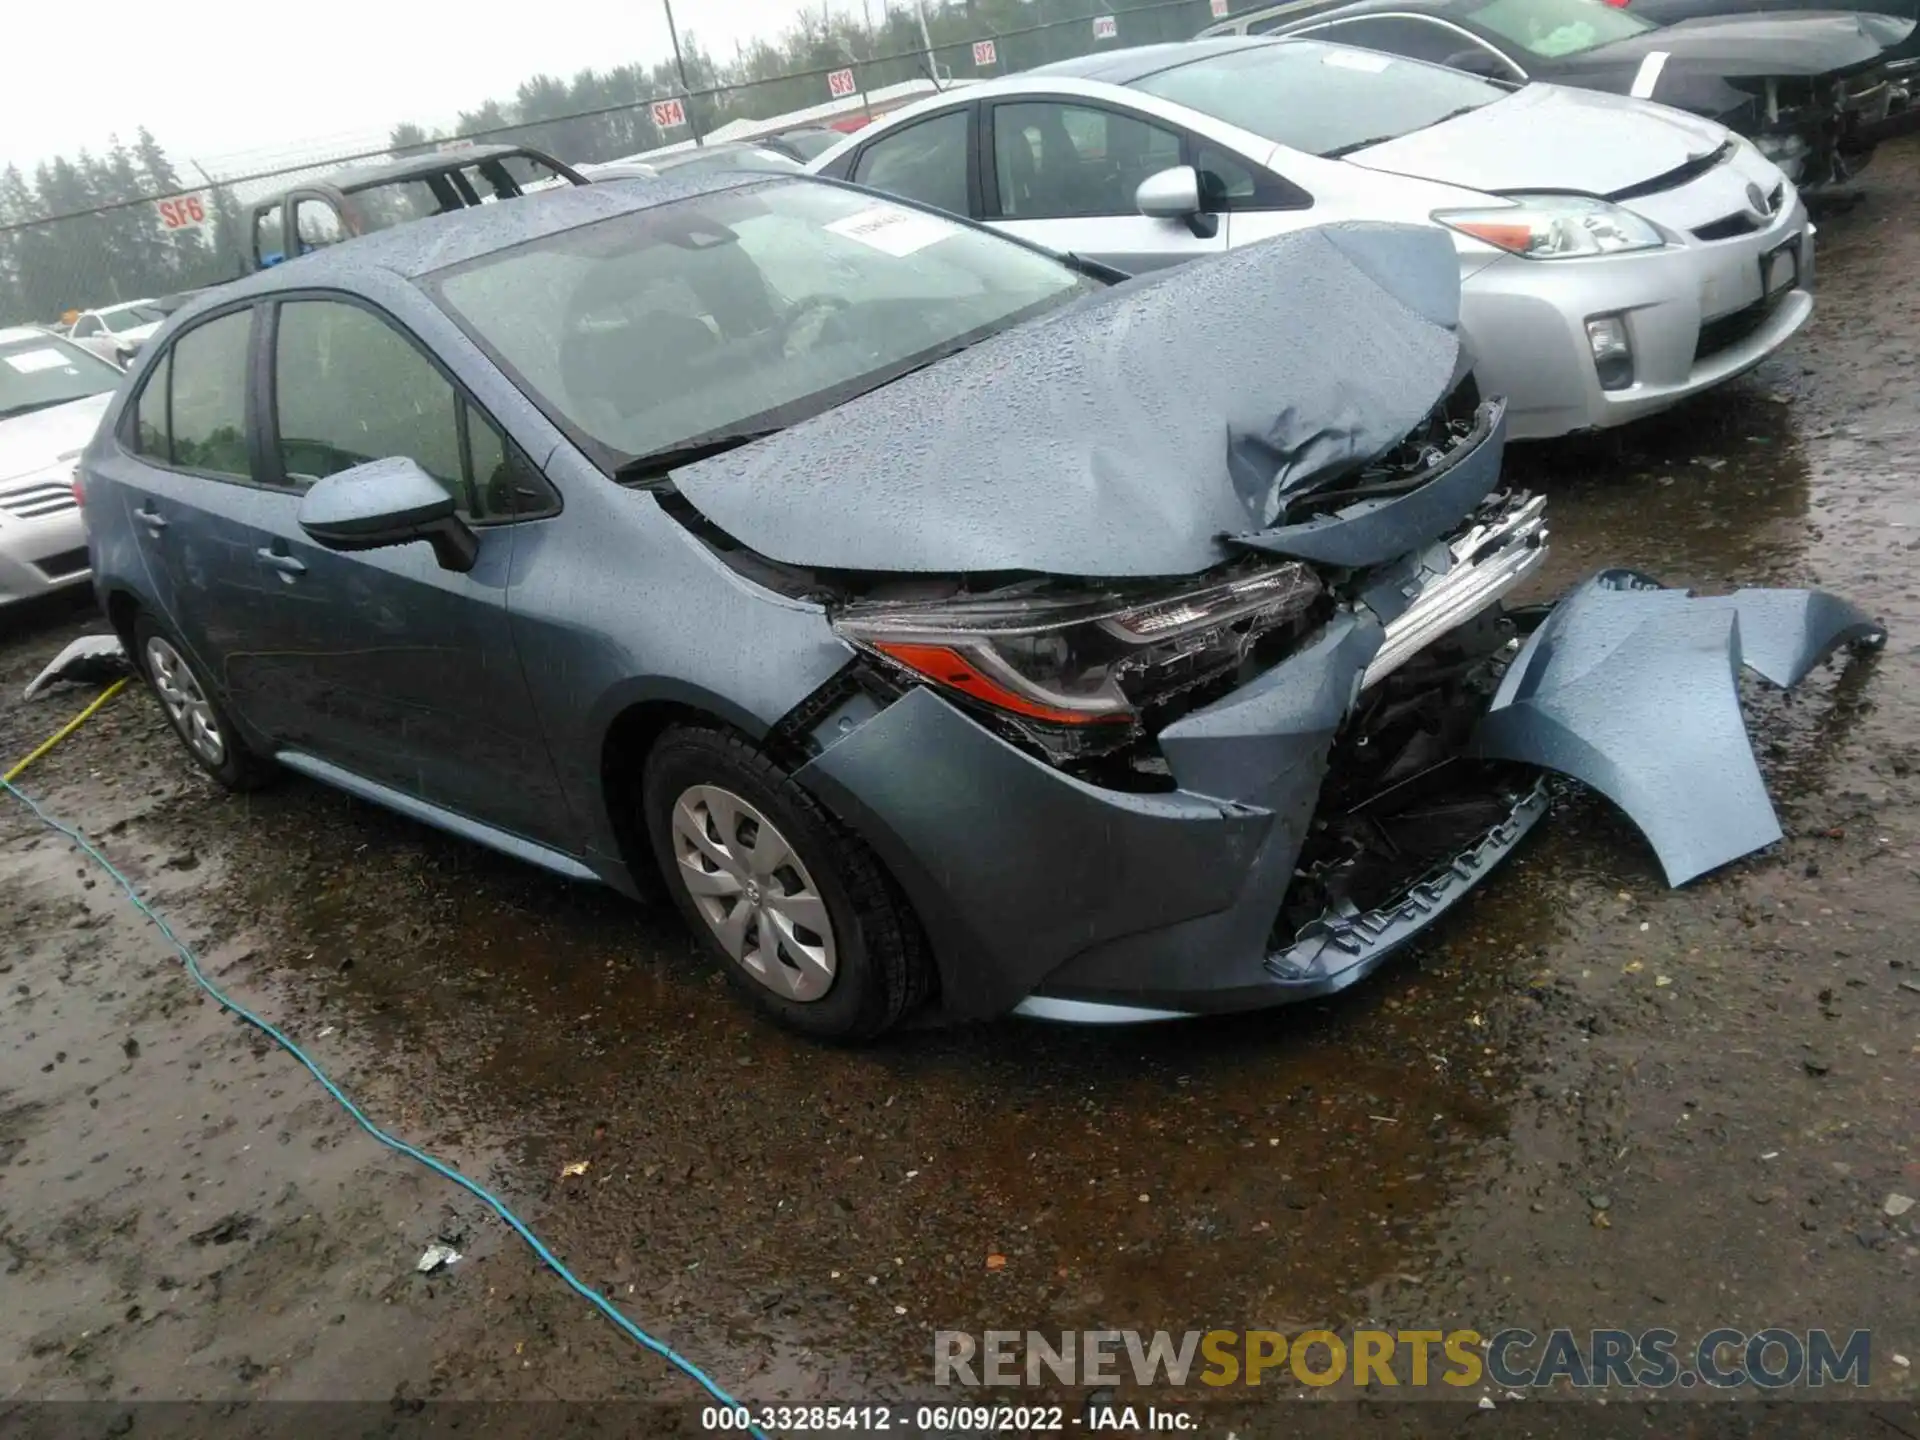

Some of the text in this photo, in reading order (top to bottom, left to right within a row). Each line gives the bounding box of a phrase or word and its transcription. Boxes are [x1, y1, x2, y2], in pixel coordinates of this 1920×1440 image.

[830, 70, 854, 94] SF3
[655, 101, 682, 125] SF4
[160, 197, 204, 228] SF6
